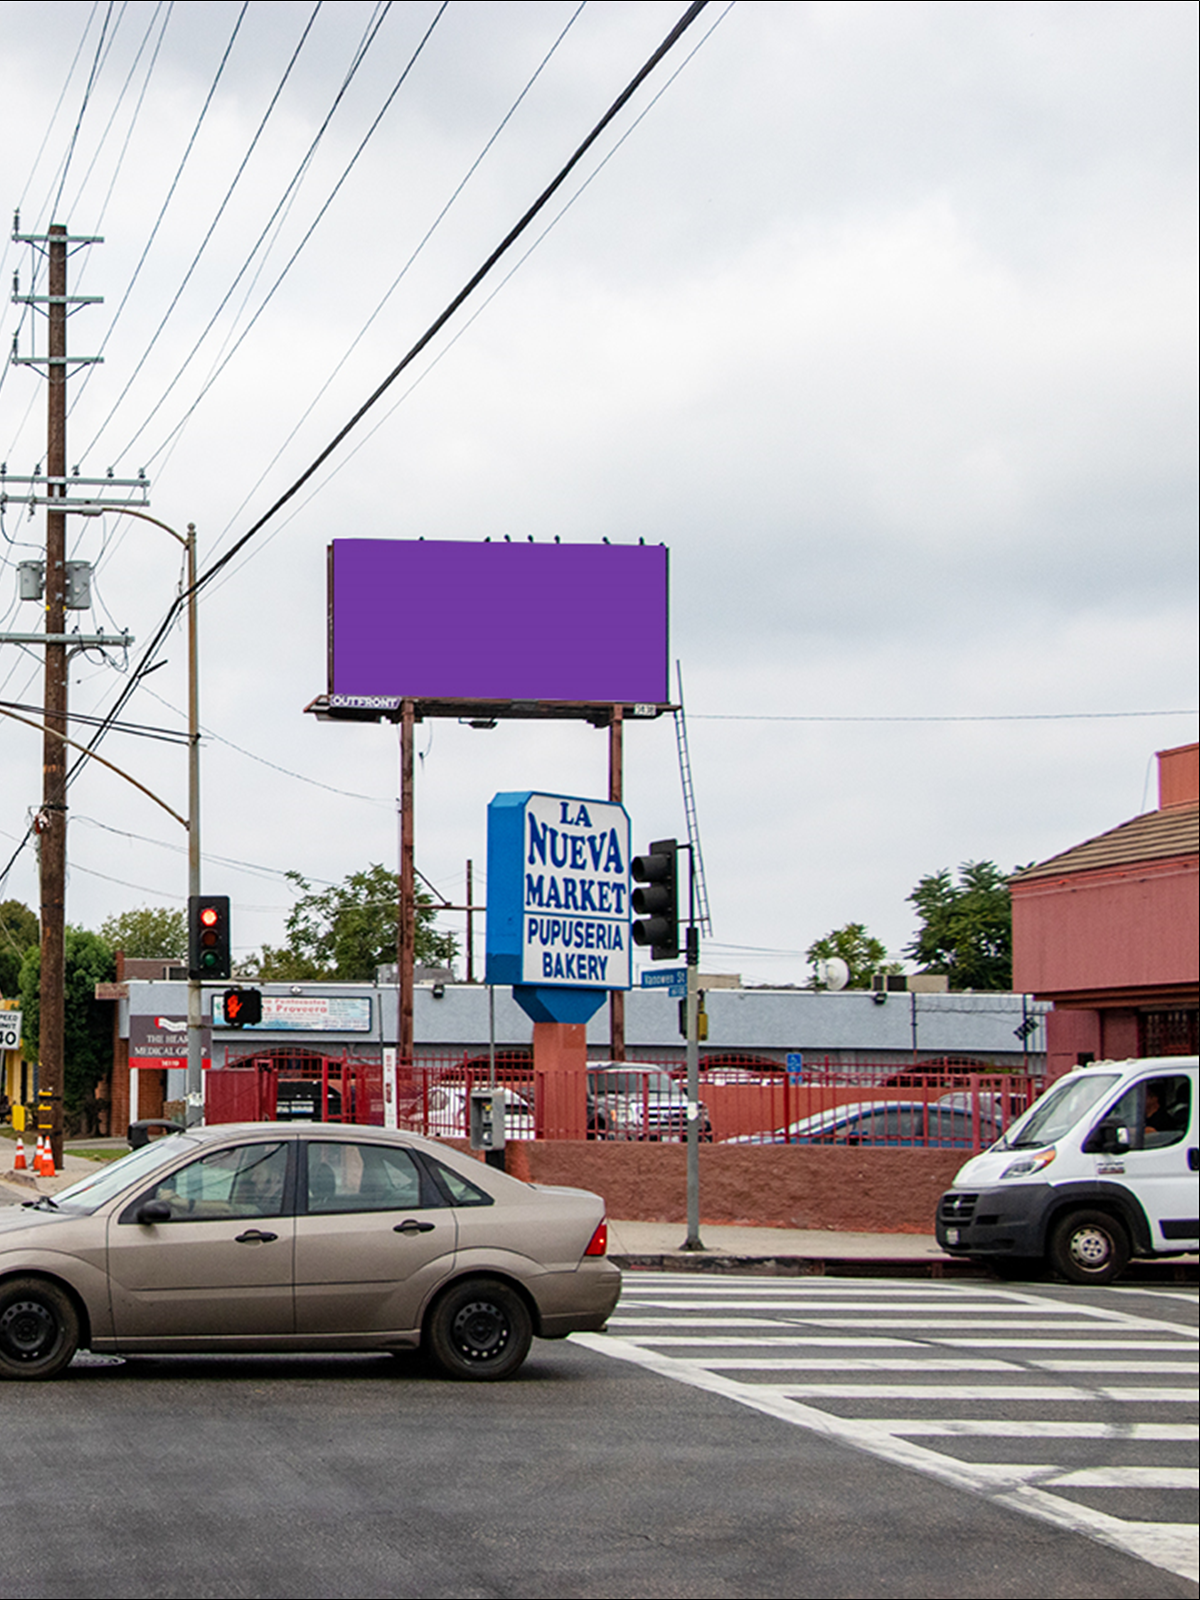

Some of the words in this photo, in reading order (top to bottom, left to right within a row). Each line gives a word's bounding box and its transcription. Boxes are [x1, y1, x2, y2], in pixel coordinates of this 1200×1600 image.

[333, 695, 399, 709] OUTFRONT
[560, 801, 592, 828] LA
[527, 811, 624, 874] NUEVA
[525, 873, 626, 914] MARKET
[528, 917, 624, 951] PUPUSERIA
[542, 951, 608, 981] BAKERY
[676, 971, 686, 983] St
[134, 1046, 175, 1056] MEDICAL
[175, 1047, 207, 1056] GRP
[146, 1034, 165, 1043] THE
[165, 1034, 189, 1043] HEAR
